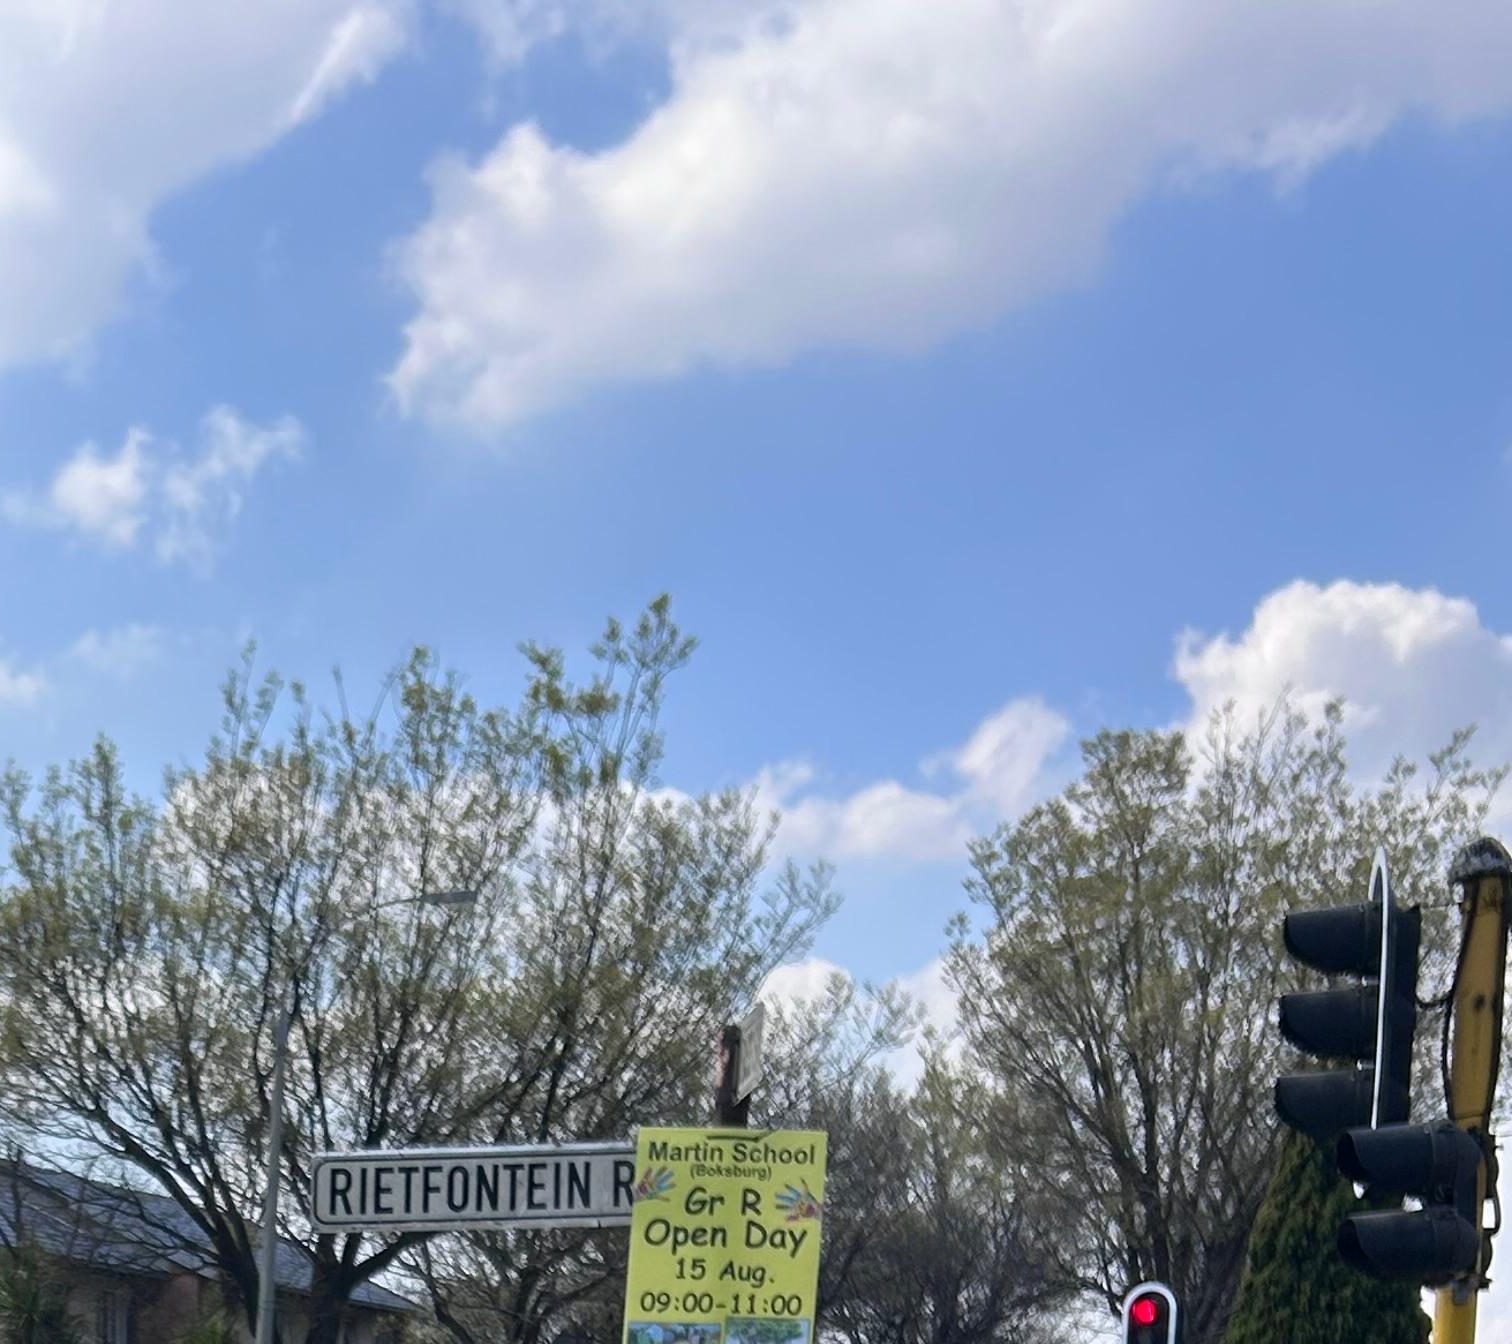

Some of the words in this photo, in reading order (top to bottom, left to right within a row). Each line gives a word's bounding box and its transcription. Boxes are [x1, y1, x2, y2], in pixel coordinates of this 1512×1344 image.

[648, 1141, 723, 1162] Martin
[732, 1142, 815, 1164] School
[329, 1161, 591, 1216] RIETFONTEIN
[612, 1159, 635, 1208] R
[690, 1164, 772, 1182] (Boksburg)
[684, 1186, 725, 1216] Gr
[740, 1187, 762, 1216] R
[644, 1218, 728, 1256] Open
[744, 1219, 808, 1259] Day
[675, 1258, 707, 1280] 15
[718, 1260, 775, 1289] Aug.
